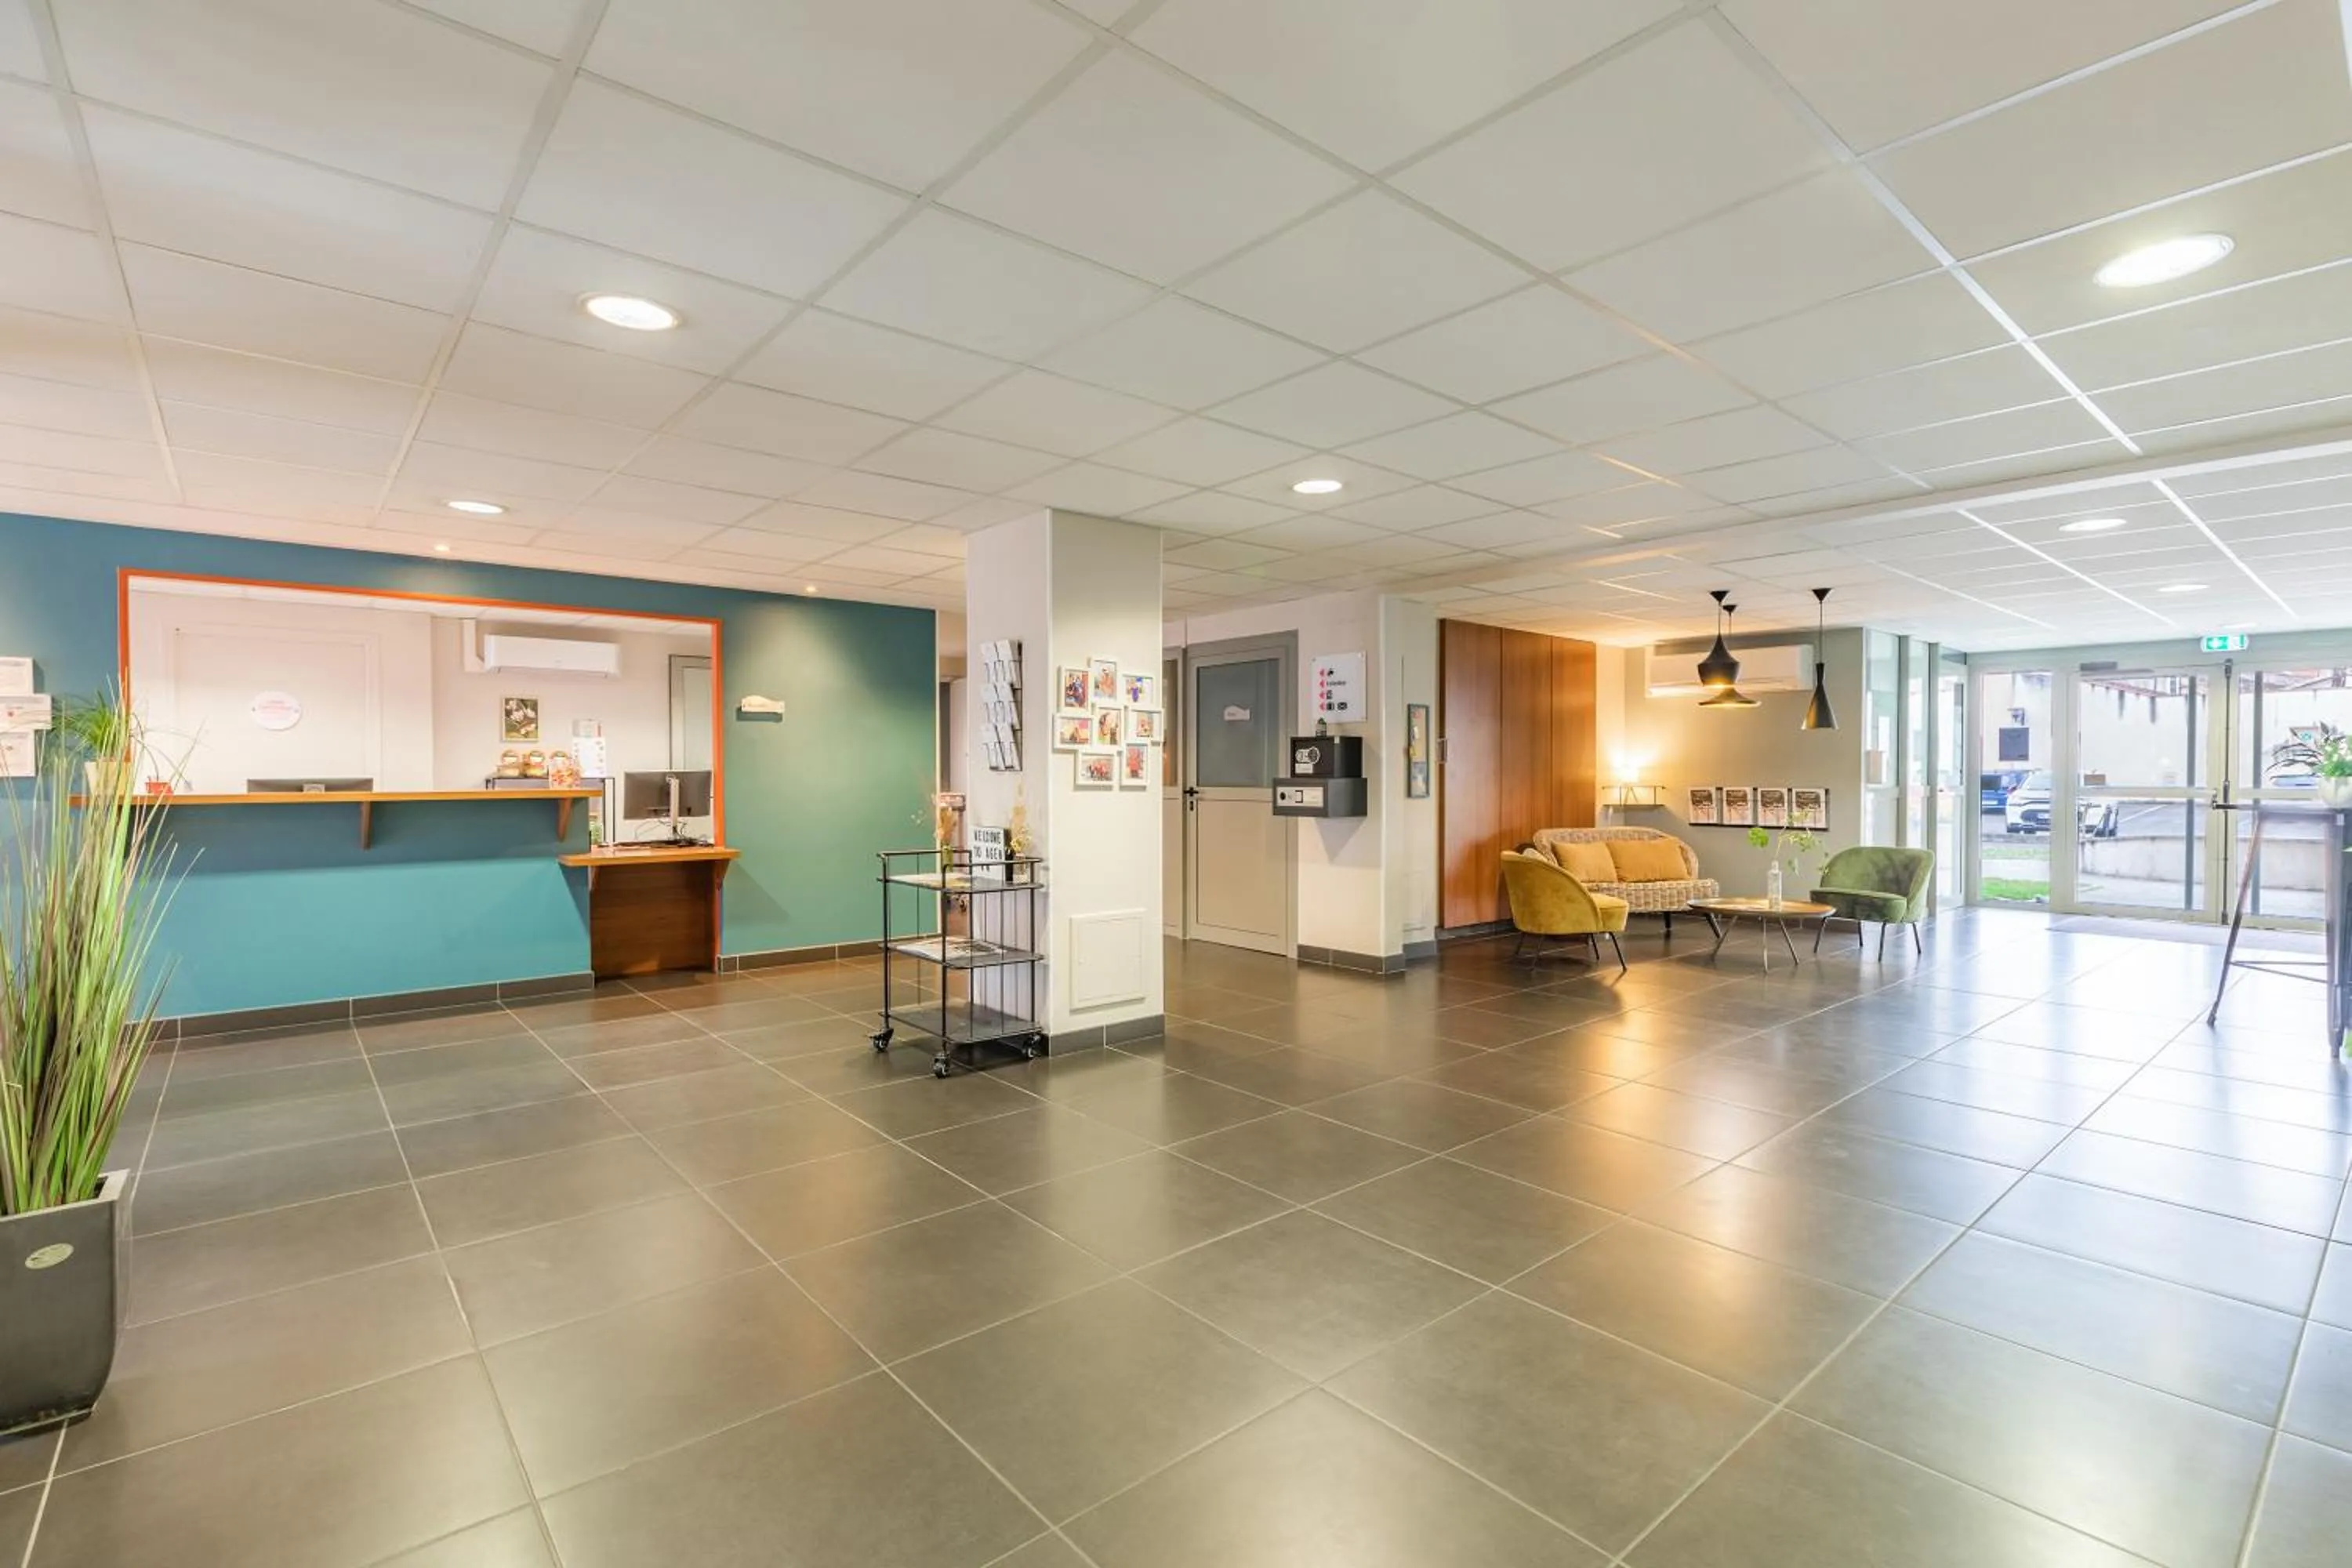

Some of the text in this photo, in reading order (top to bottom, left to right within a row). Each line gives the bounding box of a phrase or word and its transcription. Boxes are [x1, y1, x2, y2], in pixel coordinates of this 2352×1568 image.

[974, 829, 1001, 844] WELCOME
[973, 846, 1003, 860] TO AGEN
